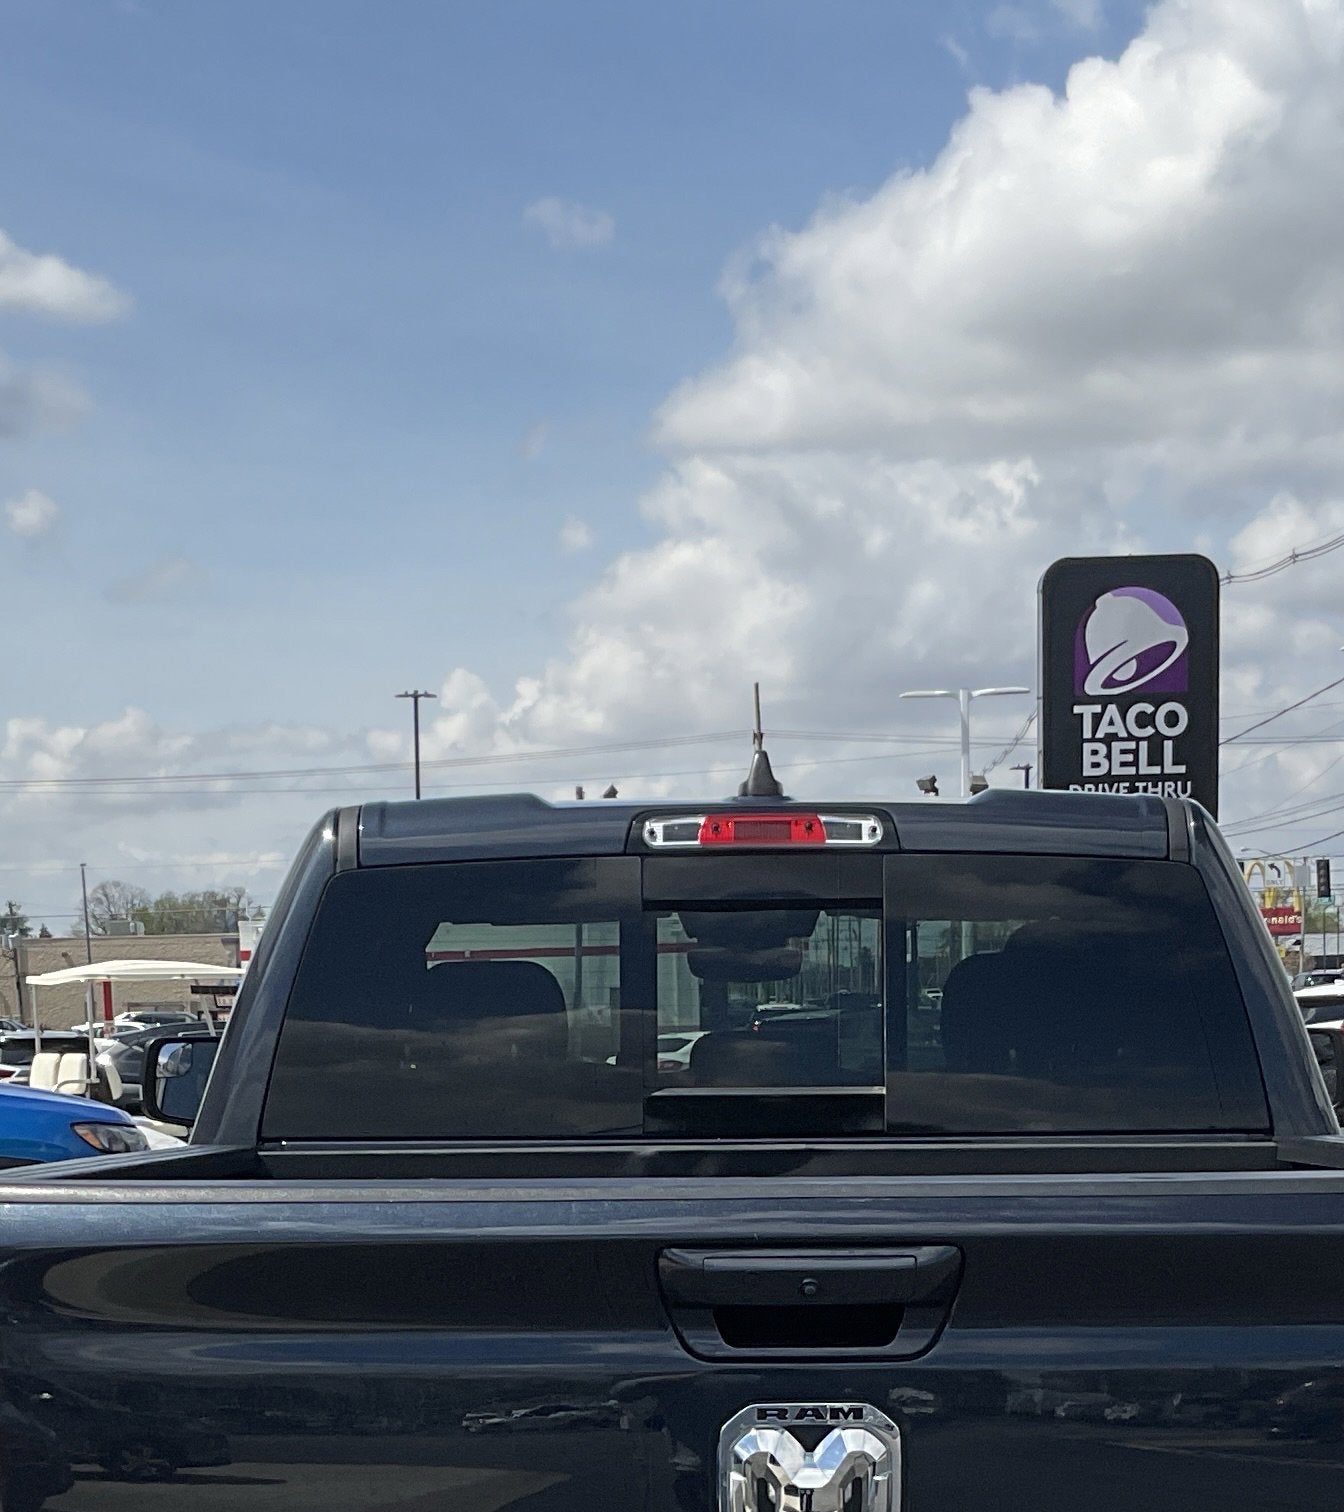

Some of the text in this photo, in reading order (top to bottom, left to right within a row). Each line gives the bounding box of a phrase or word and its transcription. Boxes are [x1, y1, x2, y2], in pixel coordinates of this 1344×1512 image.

[1072, 701, 1189, 739] TACO
[1082, 739, 1187, 777] BELL
[1134, 780, 1192, 798] THRU
[756, 1407, 864, 1420] RAM
